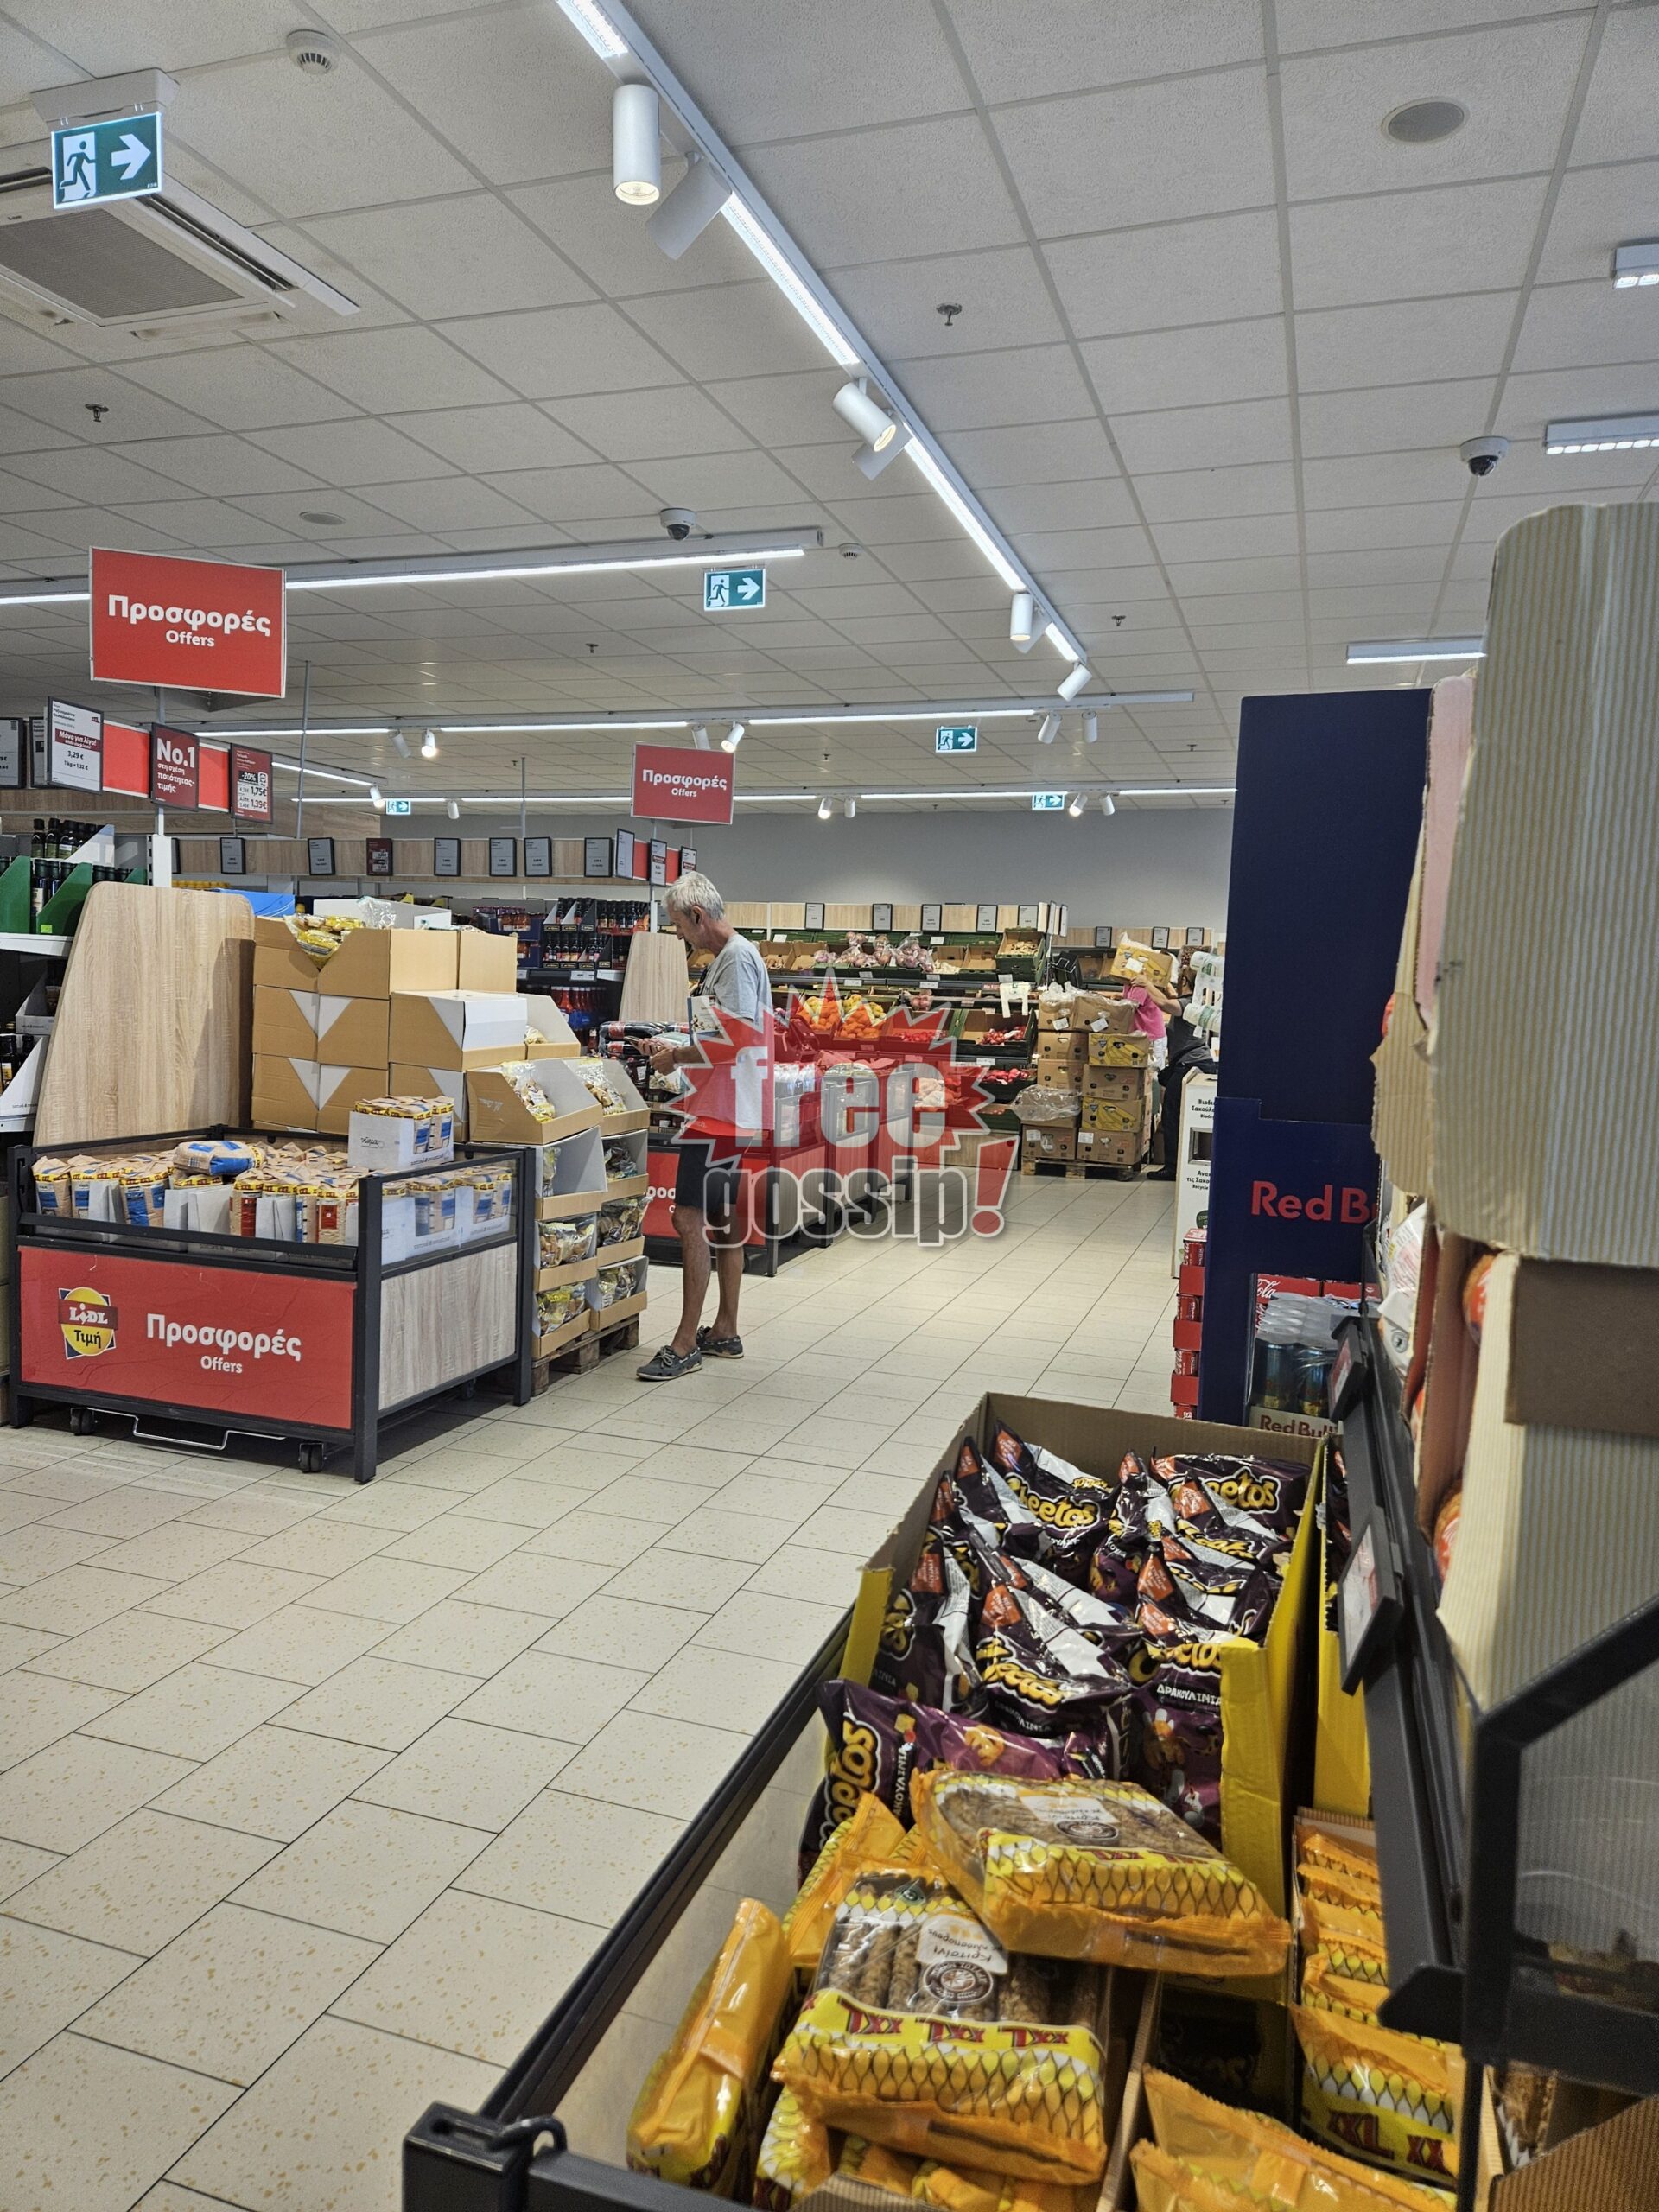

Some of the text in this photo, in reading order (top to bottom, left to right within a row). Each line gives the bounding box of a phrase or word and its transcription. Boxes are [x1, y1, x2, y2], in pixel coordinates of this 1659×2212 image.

[108, 594, 271, 637] Προσφορές
[165, 629, 215, 648] Offers
[67, 750, 79, 759] 3,29
[156, 737, 195, 768] No.1
[157, 782, 176, 793] τιμής
[242, 772, 257, 782] -20%
[642, 768, 728, 791] Προσφορές
[671, 787, 697, 798] Offers
[1252, 1181, 1334, 1222] Red
[73, 1328, 102, 1349] Τιμή
[146, 1313, 302, 1362] Προσφορές
[200, 1355, 243, 1374] Offers
[1260, 1414, 1295, 1434] Red
[836, 1994, 1069, 2048] XXL XXL XXL
[1407, 2134, 1450, 2173] XX
